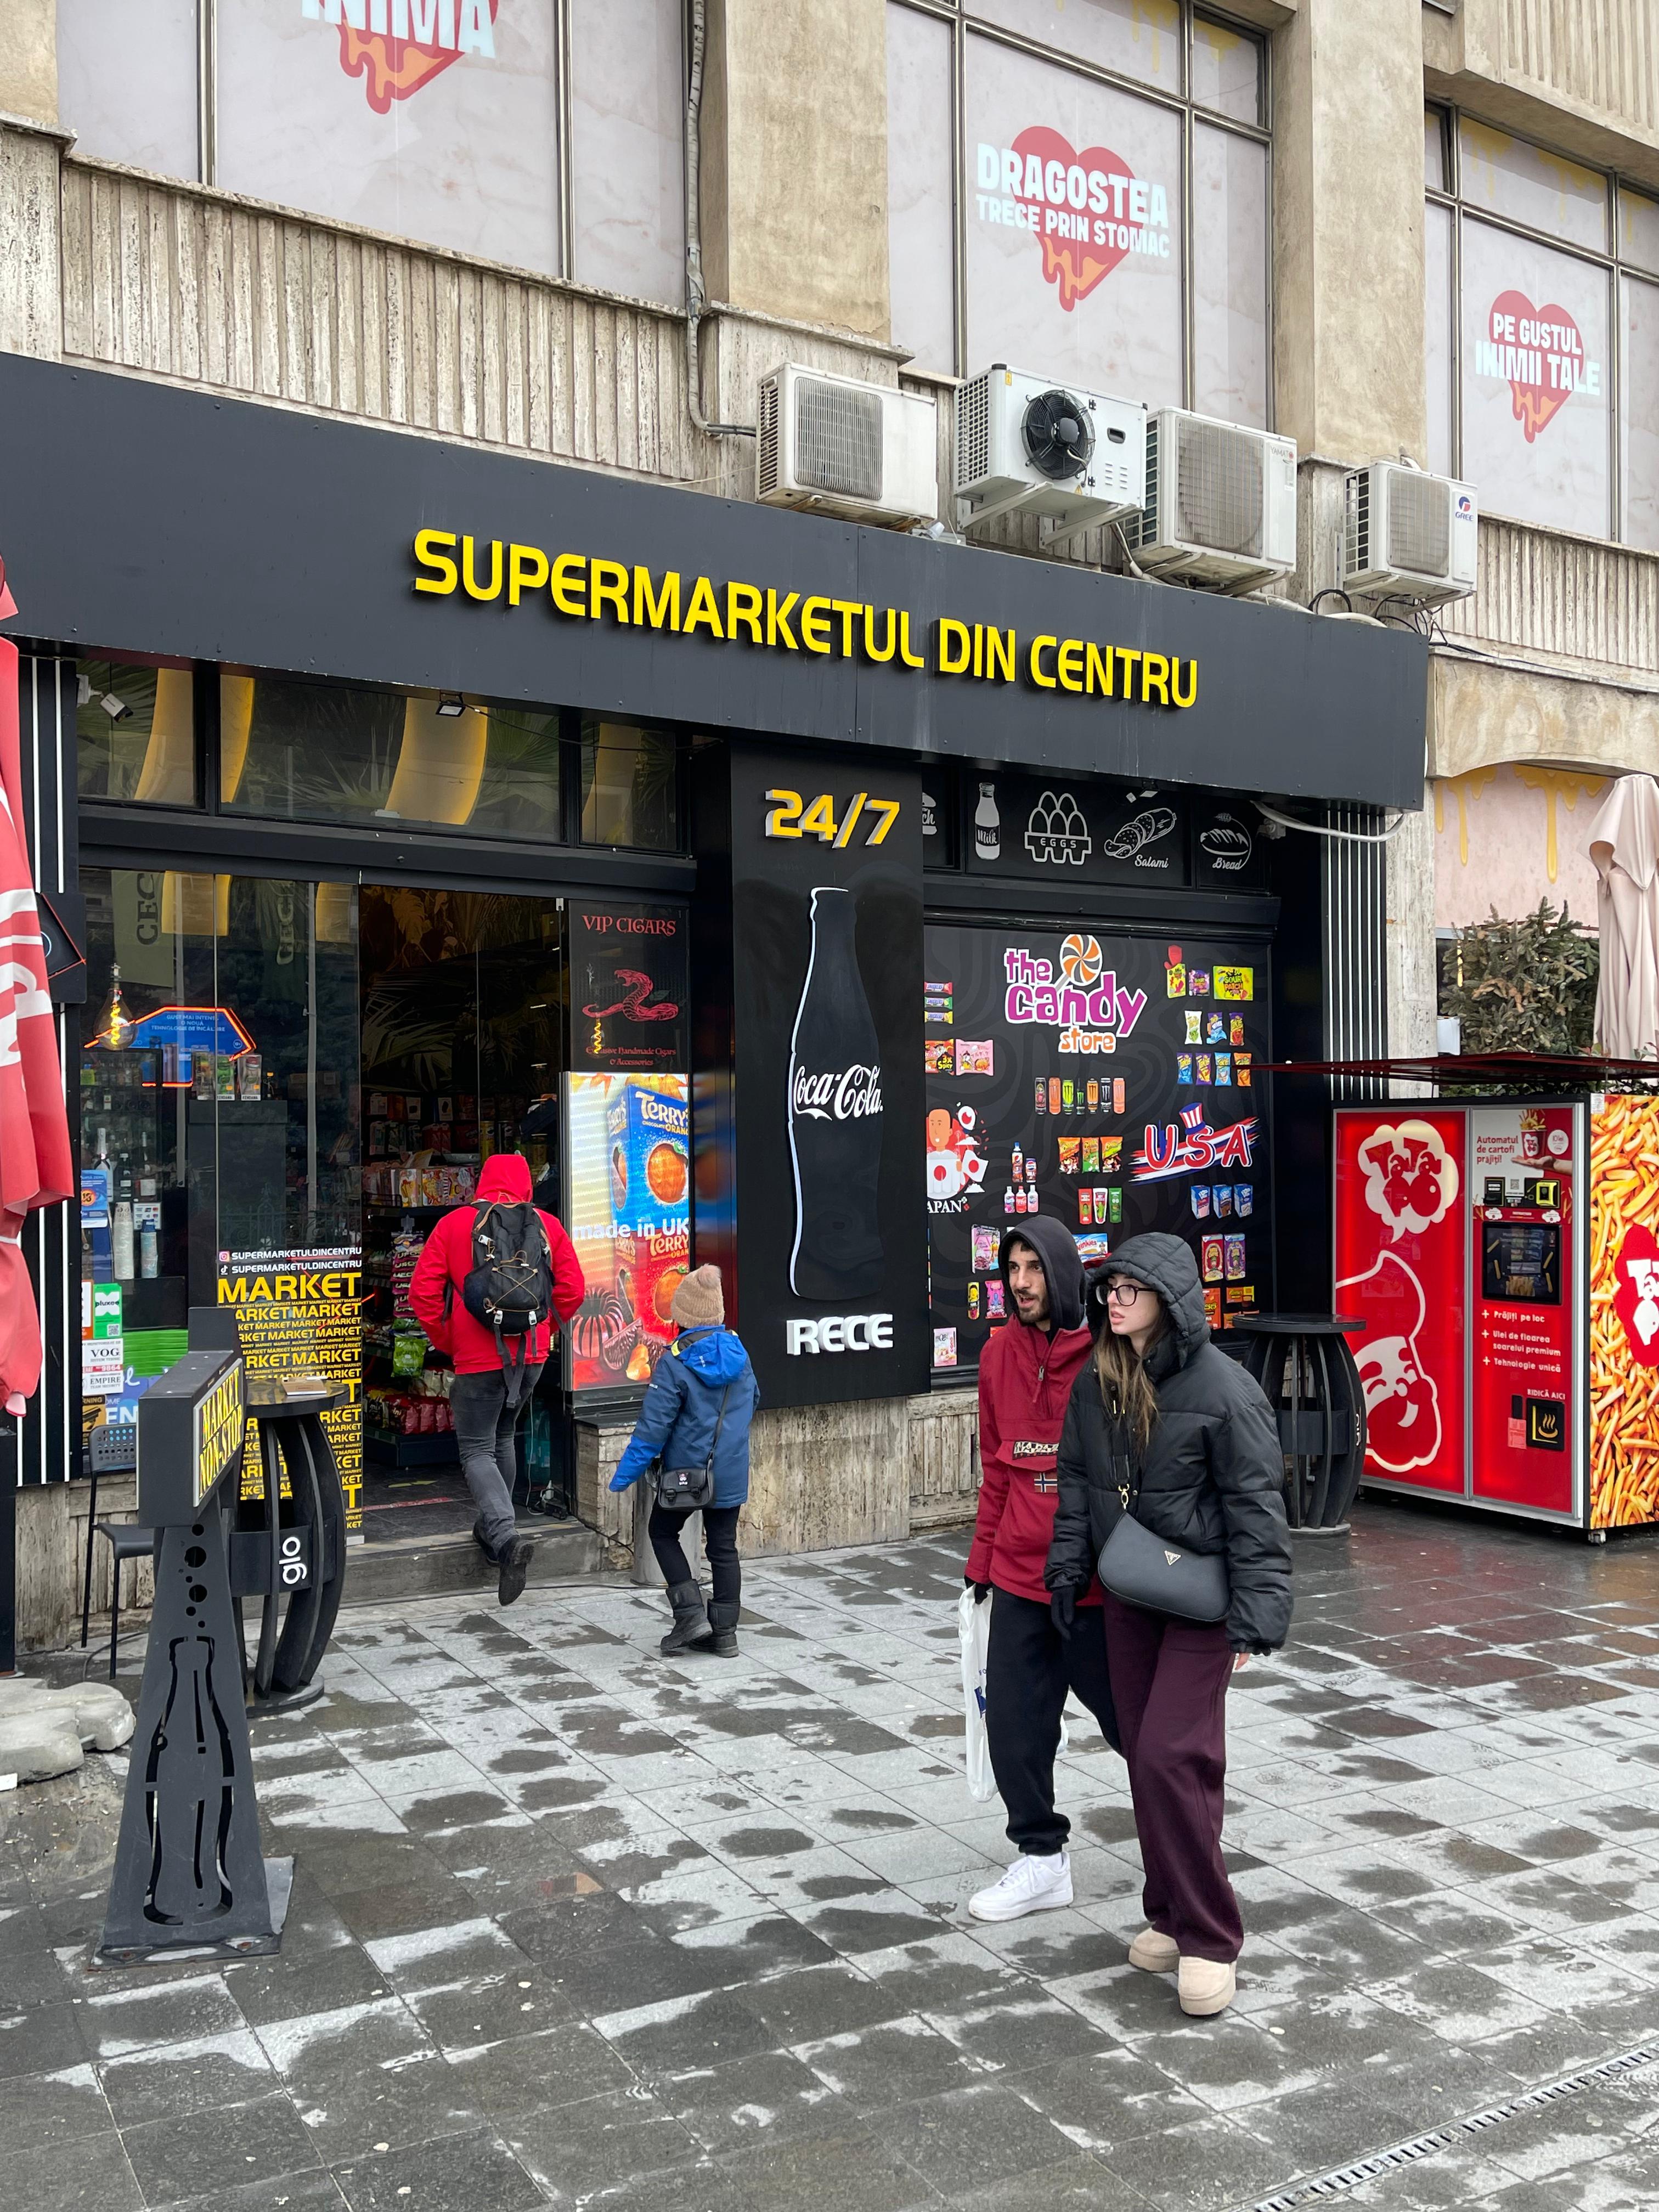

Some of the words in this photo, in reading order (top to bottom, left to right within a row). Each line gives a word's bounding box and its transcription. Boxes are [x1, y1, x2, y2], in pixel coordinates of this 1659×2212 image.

[302, 0, 496, 58] IMA
[977, 143, 1169, 228] DRAGOSTEA
[976, 194, 1040, 232] TRECE
[1046, 208, 1088, 242] PRIN
[1093, 220, 1170, 258] STOMAC
[1493, 312, 1515, 342] PE
[1520, 318, 1582, 355] GUSTUL
[1476, 340, 1542, 386] INIMII
[1547, 353, 1600, 396] TALE
[1455, 511, 1474, 522] GREE
[414, 528, 924, 669] SUPERMARKETUL
[938, 617, 1016, 683] DIN
[1031, 634, 1198, 709] CENTRU
[765, 789, 900, 849] 24/7
[977, 829, 997, 845] Milk
[1040, 837, 1077, 849] EGGS
[1134, 854, 1169, 869] Salami
[1212, 857, 1242, 870] Bread
[582, 915, 613, 934] VIP
[616, 917, 676, 936] CIGARS
[1005, 948, 1053, 984] the
[1058, 1026, 1116, 1054] store
[794, 1064, 883, 1120] Coca-Cola
[1144, 1124, 1252, 1170] USA
[1477, 1136, 1519, 1144] Automatul
[1477, 1145, 1486, 1153] de
[1488, 1146, 1514, 1154] cartofi
[927, 1200, 962, 1214] APAN
[573, 1219, 631, 1240] made
[637, 1218, 655, 1237] in
[662, 1217, 689, 1235] UK
[232, 1247, 362, 1260] SUPERMARKETULDINCENTRU
[232, 1260, 362, 1274] SUPERMARKETULDINCENTRU
[218, 1272, 362, 1304] MARKET
[235, 1307, 290, 1322] ARKET
[292, 1303, 362, 1318] MARKET
[1521, 1314, 1531, 1322] pe
[1532, 1314, 1545, 1322] loc
[255, 1321, 291, 1330] MARKET
[292, 1319, 326, 1327] MARKET
[327, 1317, 362, 1325] MARKET
[239, 1332, 266, 1342] RKET
[268, 1329, 314, 1340] MARKET
[316, 1326, 362, 1338] MARKET
[786, 1313, 894, 1356] RECE
[1493, 1330, 1506, 1339] Ulei
[1509, 1331, 1519, 1340] de
[1521, 1333, 1550, 1343] floarea
[91, 1348, 120, 1358] VOG
[246, 1353, 290, 1368] RKET
[292, 1348, 362, 1365] MARKET
[1493, 1343, 1524, 1352] soarelui
[1526, 1346, 1561, 1357] premium
[1494, 1357, 1536, 1370] Tehnologie
[90, 1376, 121, 1385] EMPIRE
[106, 1406, 138, 1425] EN
[202, 1366, 240, 1449] MARKET
[320, 1408, 362, 1424] RKET
[328, 1423, 362, 1433] MARKET
[328, 1432, 362, 1443] ARKET
[199, 1403, 242, 1499] NON-STOP
[336, 1454, 362, 1469] KET
[342, 1474, 362, 1485] KET
[347, 1521, 362, 1529] KET
[279, 1537, 307, 1584] glo
